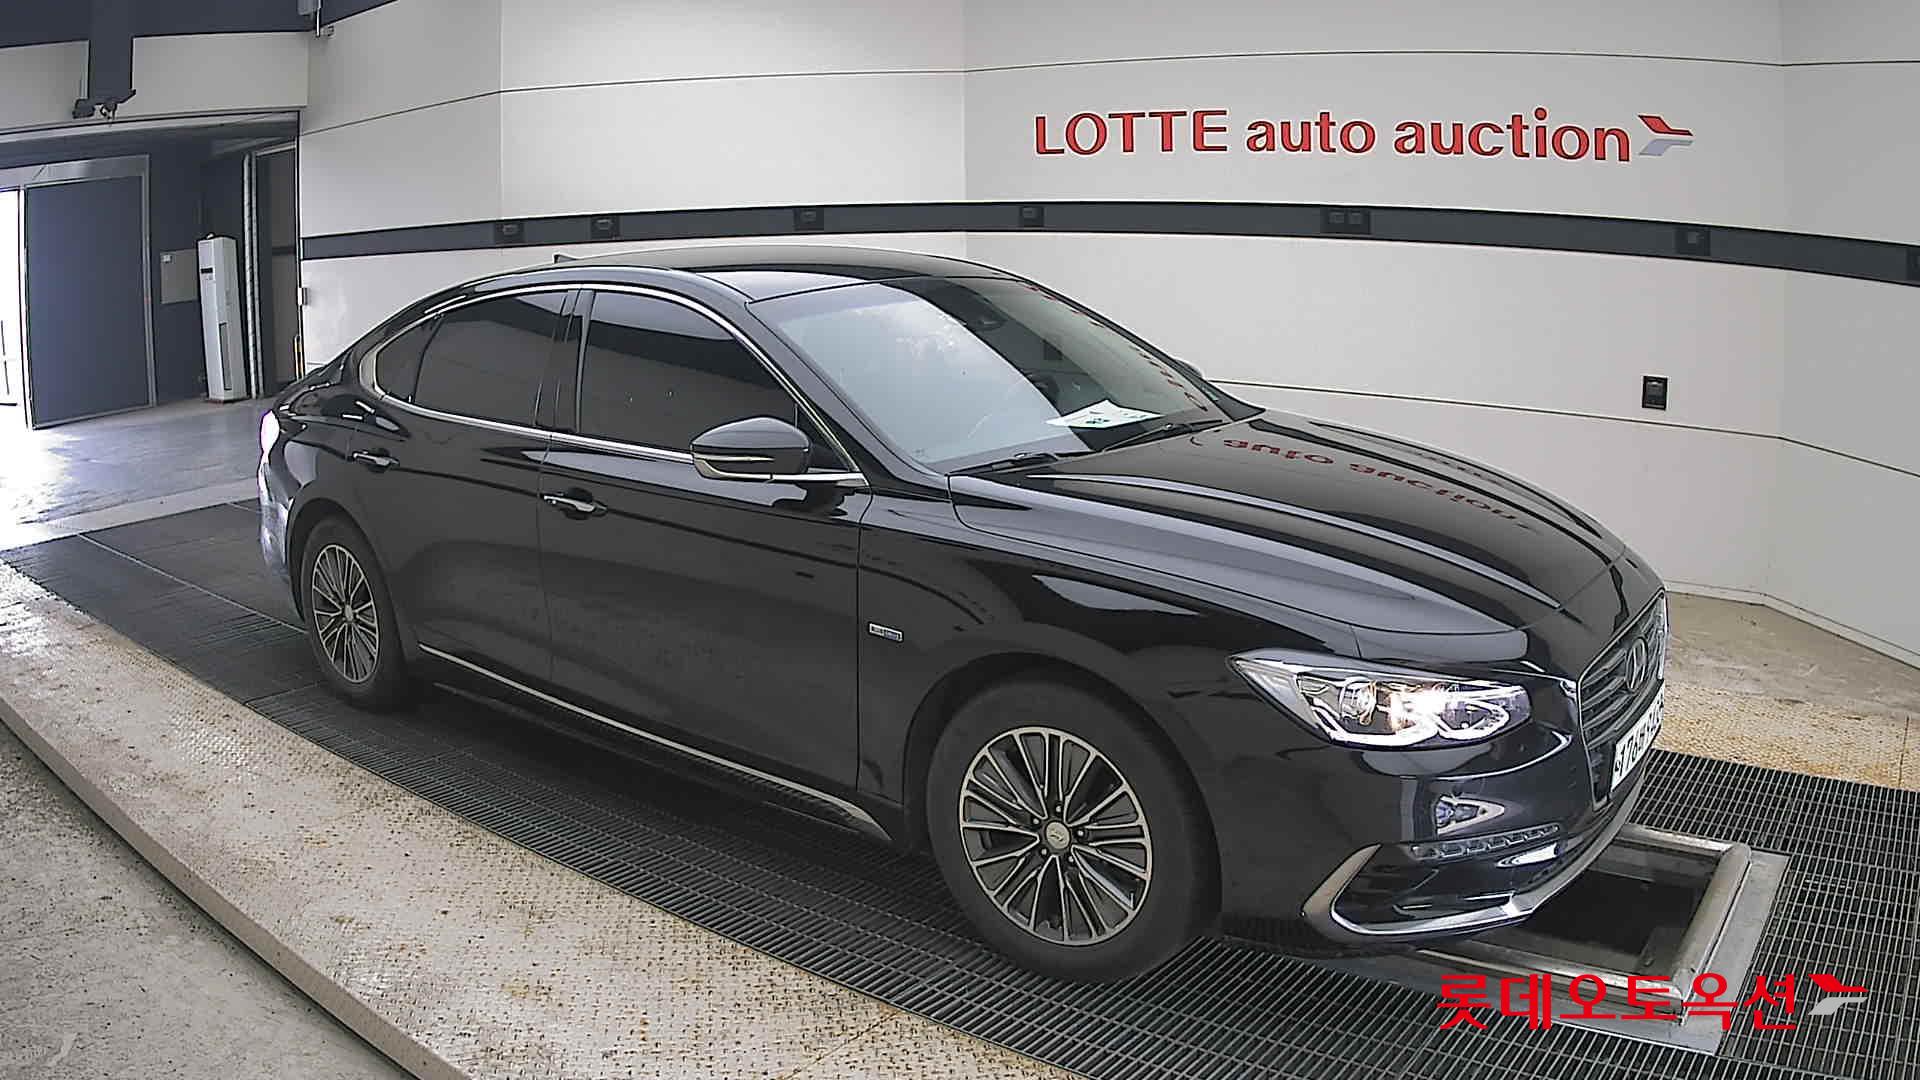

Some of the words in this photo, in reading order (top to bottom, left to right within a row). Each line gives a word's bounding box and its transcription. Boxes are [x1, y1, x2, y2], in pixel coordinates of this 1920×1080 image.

[1034, 109, 1228, 156] LOTTE
[1246, 111, 1377, 154] auto
[1393, 107, 1632, 162] auction
